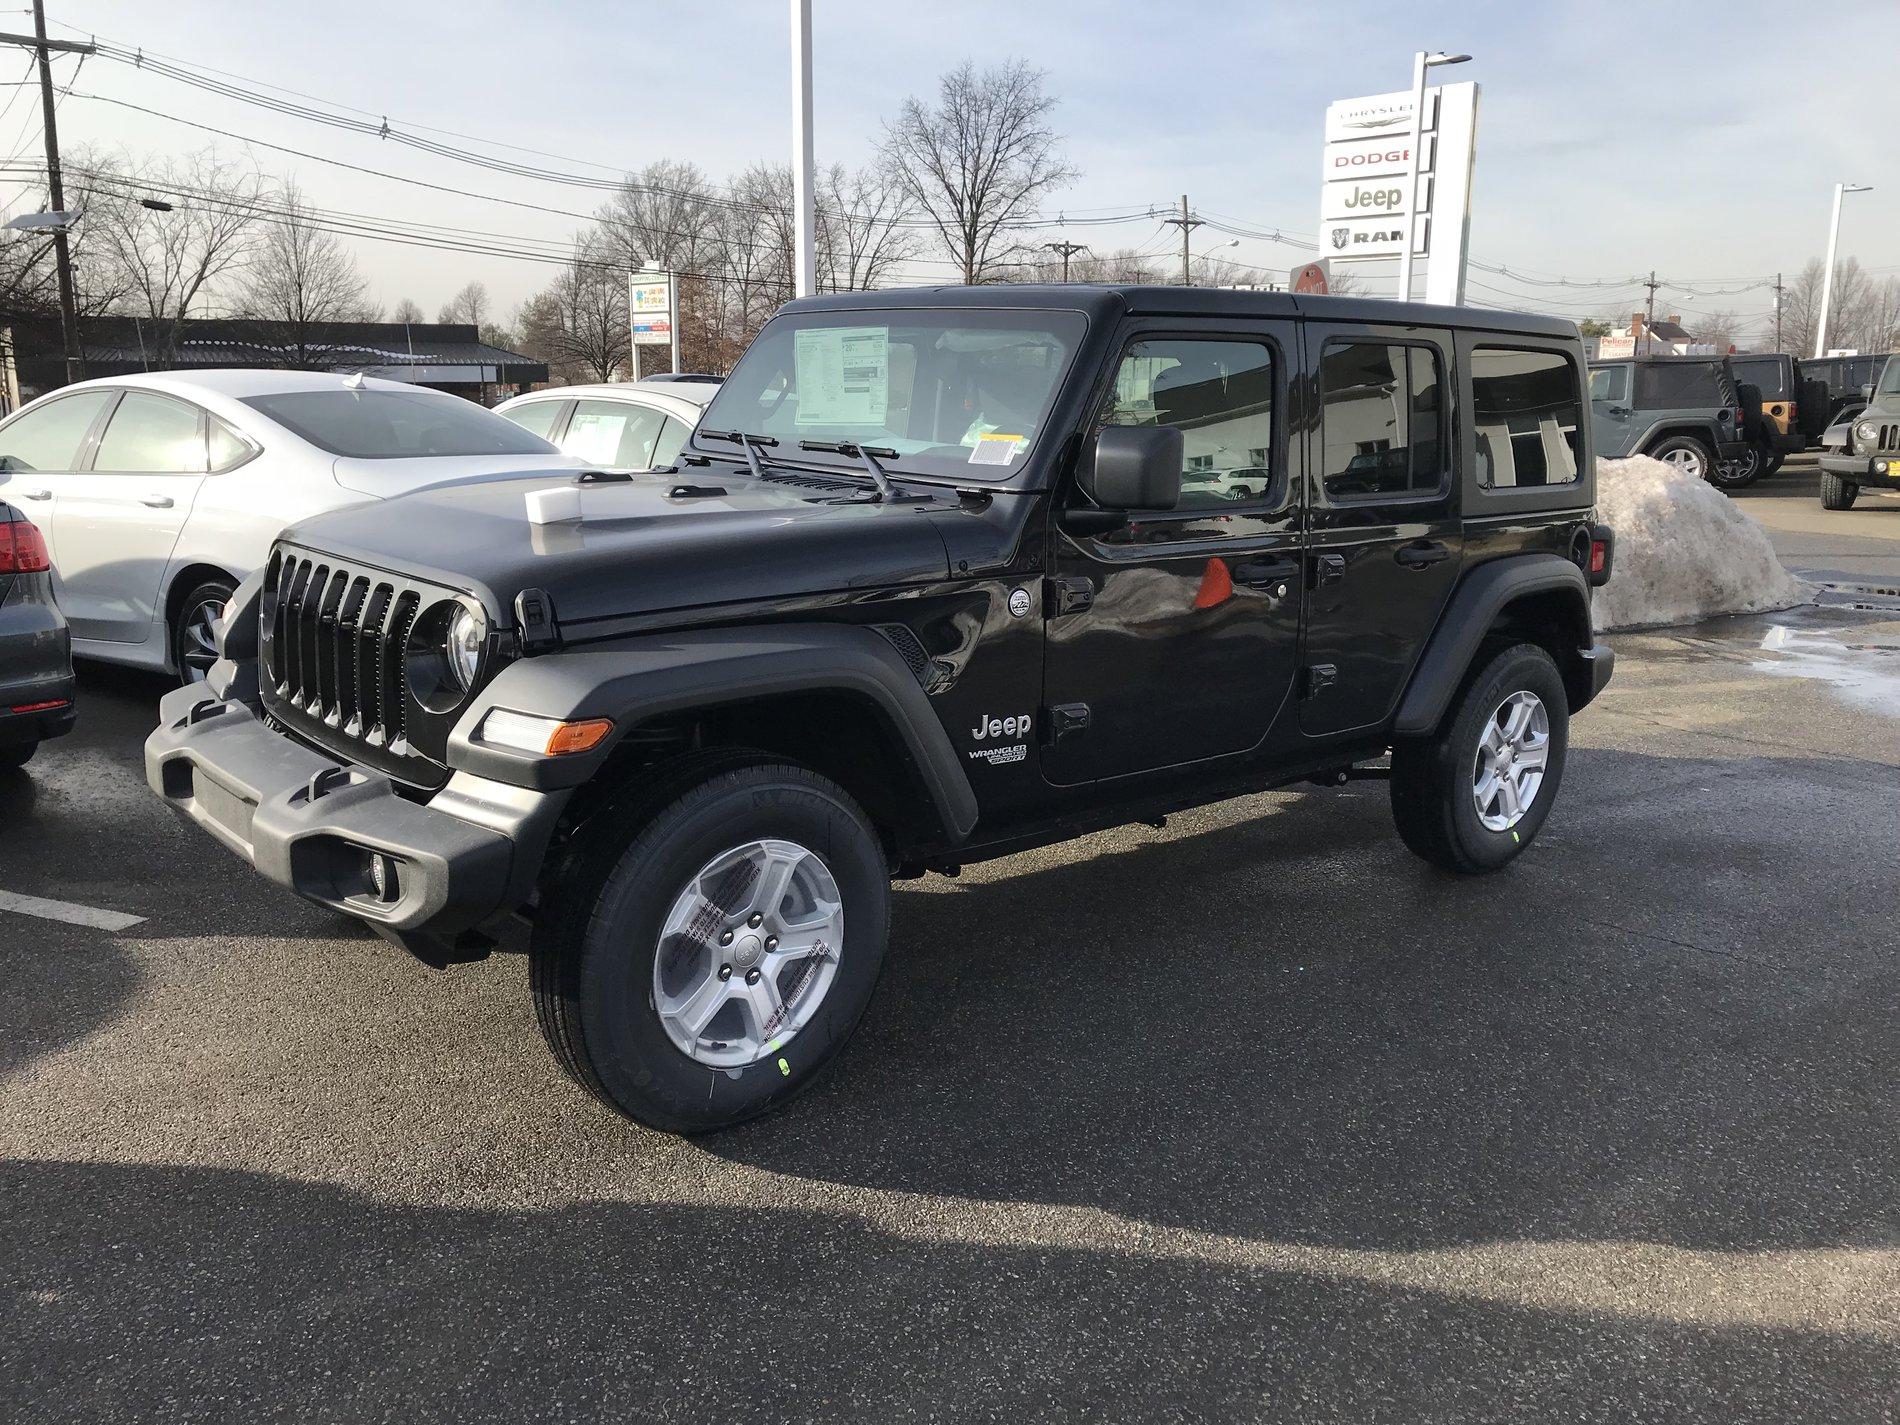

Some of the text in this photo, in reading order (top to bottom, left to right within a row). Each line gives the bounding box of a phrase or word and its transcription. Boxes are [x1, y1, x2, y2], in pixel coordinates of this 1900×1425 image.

[1335, 150, 1409, 167] DODGE
[1344, 187, 1402, 210] Jeep
[1601, 337, 1633, 345] Pelican
[972, 714, 1032, 740] Jeep
[968, 744, 1027, 759] WRANGLER
